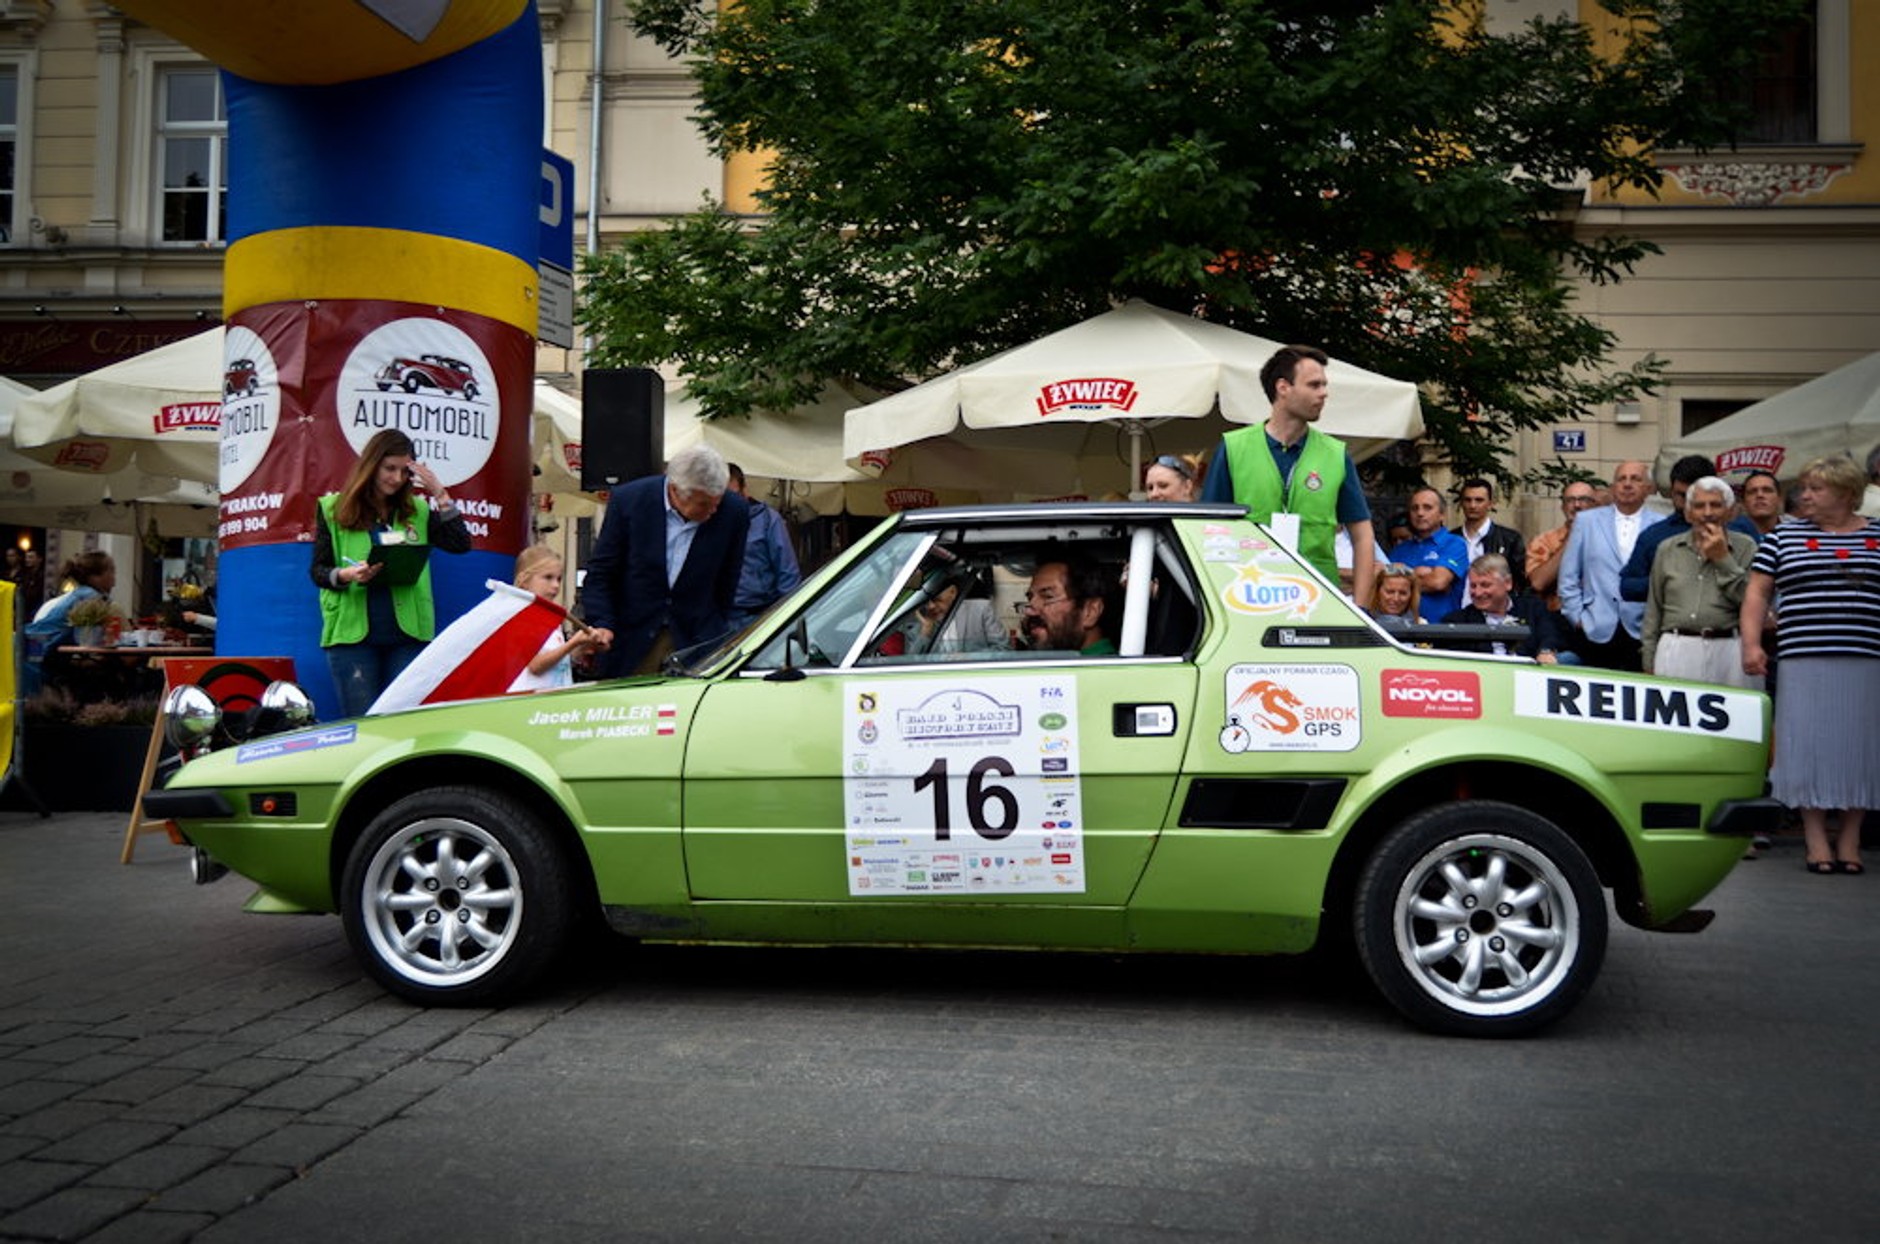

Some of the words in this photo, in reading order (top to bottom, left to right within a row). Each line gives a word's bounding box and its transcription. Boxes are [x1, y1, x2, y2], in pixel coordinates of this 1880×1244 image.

[1050, 380, 1128, 404] ŻYWIEC
[354, 400, 490, 440] AUTOMOBIL
[413, 438, 450, 461] OTEL
[1720, 448, 1780, 469] ŻYWIEC
[228, 492, 284, 514] KRAKÓW
[429, 496, 502, 519] KAKÓW
[244, 516, 268, 532] 904
[1245, 584, 1299, 604] LOTTO
[1389, 687, 1474, 702] NOVOL
[1547, 678, 1730, 731] REIMS
[528, 710, 581, 726] Jacek
[586, 706, 653, 722] MILLER
[1304, 707, 1356, 721] SMOK
[1304, 722, 1342, 736] GPS
[913, 755, 1019, 842] 16
